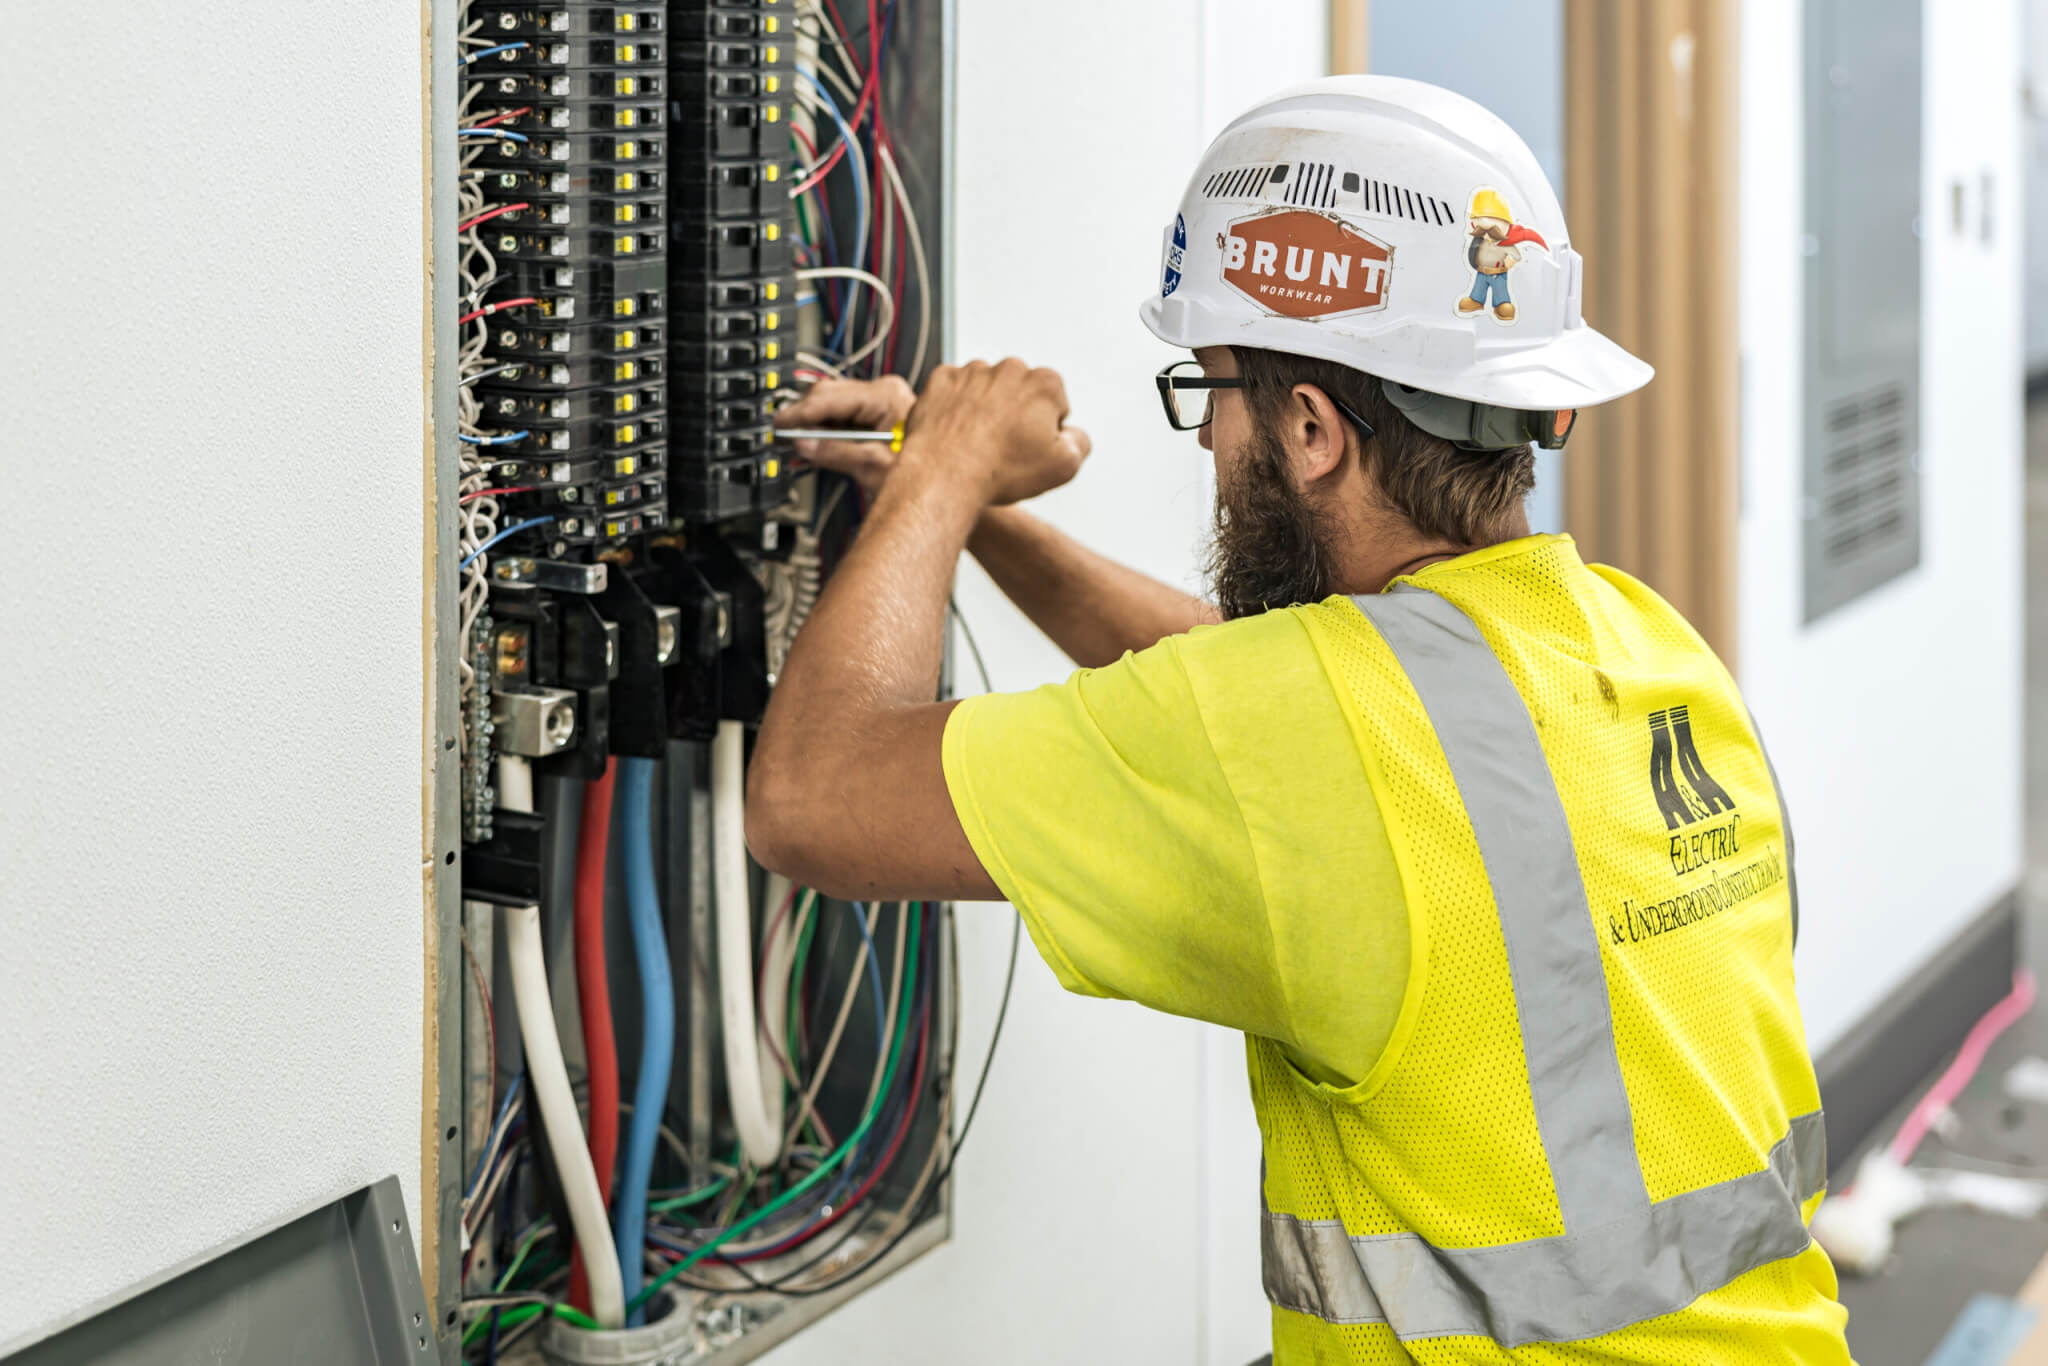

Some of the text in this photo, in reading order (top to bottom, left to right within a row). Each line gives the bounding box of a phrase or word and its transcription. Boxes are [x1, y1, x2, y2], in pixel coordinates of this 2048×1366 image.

[1224, 236, 1387, 294] BRUNT
[1259, 283, 1333, 305] WORKWEAR
[1609, 915, 1626, 946] &
